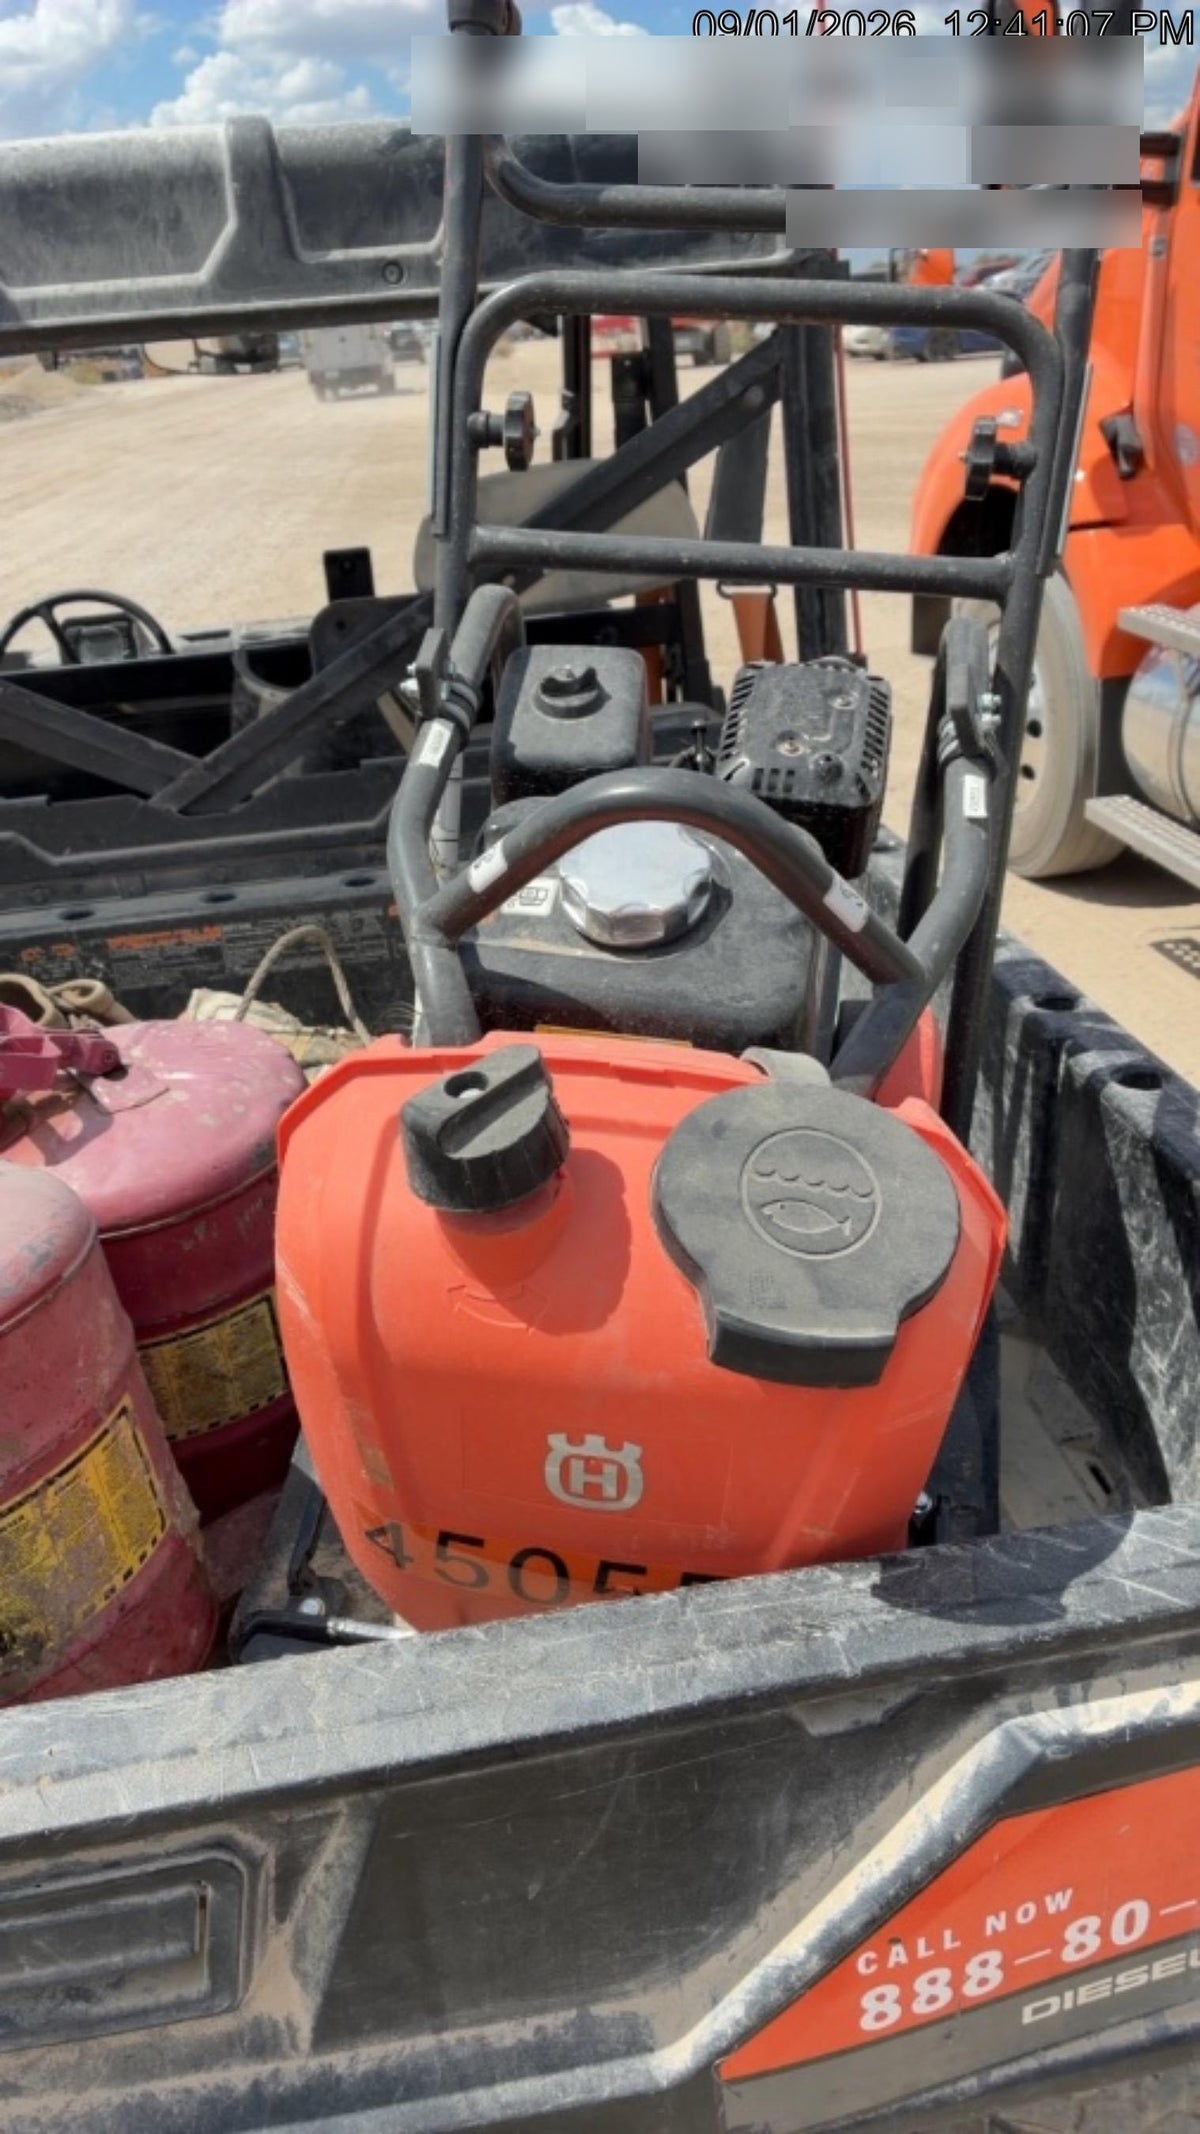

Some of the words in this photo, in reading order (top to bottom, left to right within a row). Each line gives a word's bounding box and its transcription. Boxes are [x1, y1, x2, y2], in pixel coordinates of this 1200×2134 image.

[364, 1520, 735, 1604] 4505
[856, 1929, 961, 1975] CALL
[985, 1887, 1073, 1937] NOW
